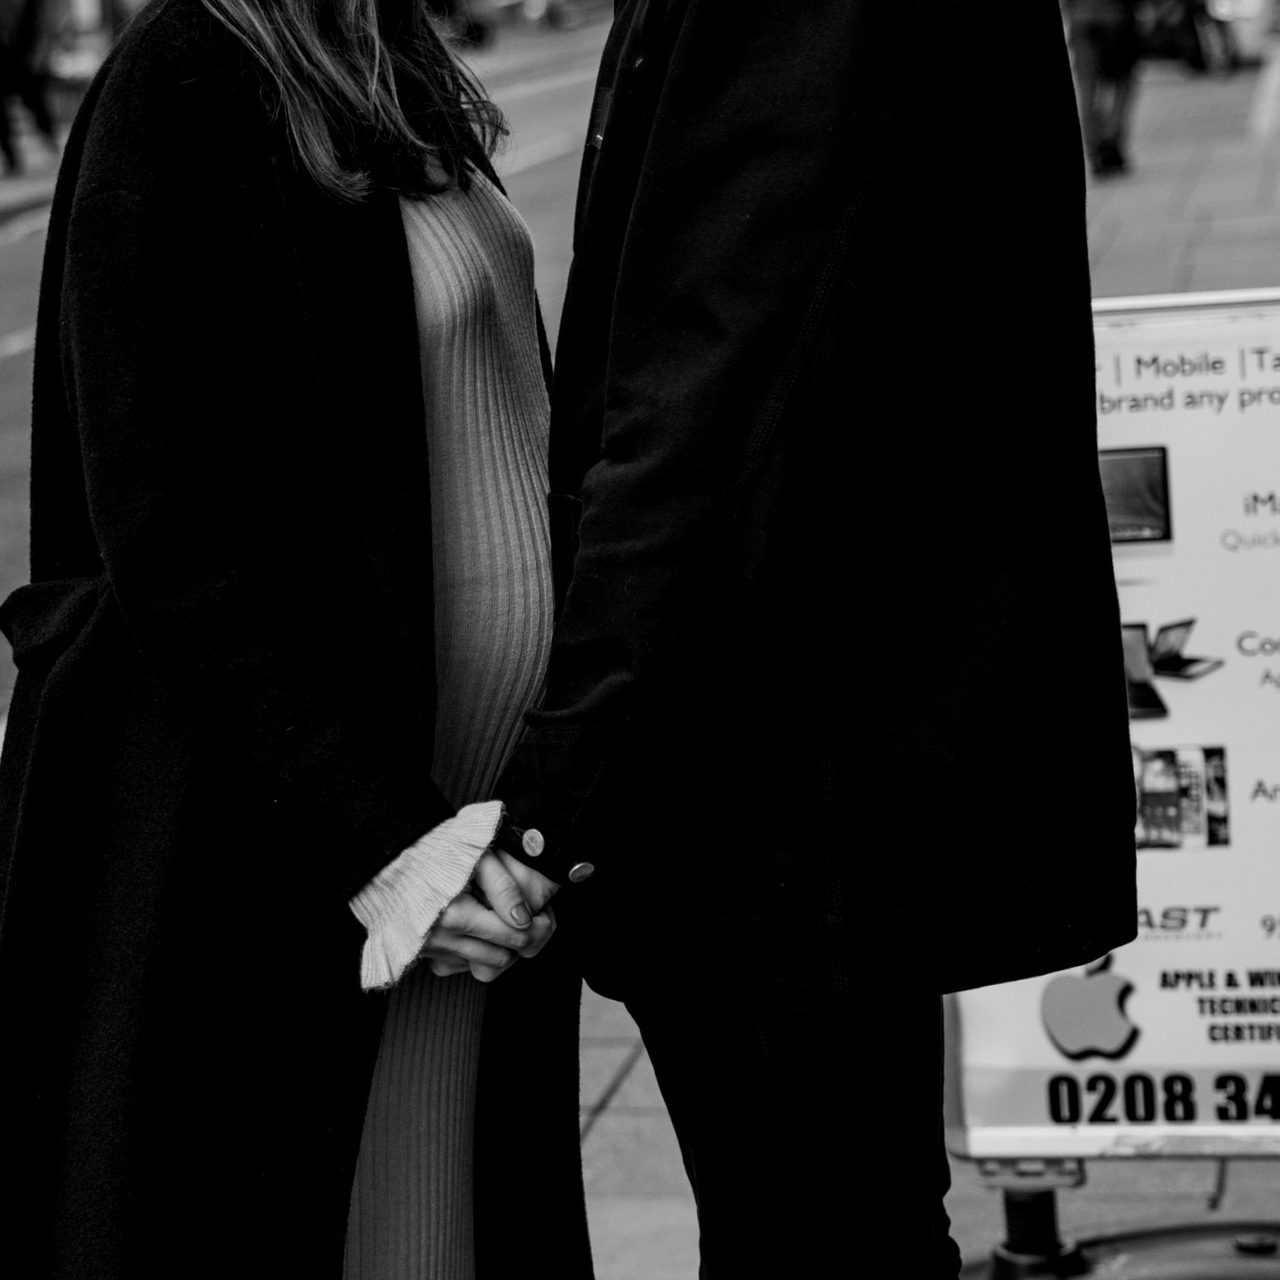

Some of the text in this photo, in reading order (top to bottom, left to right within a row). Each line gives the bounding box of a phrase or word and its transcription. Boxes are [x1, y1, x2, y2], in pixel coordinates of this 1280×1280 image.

[1135, 351, 1226, 378] Mobile
[1099, 386, 1174, 415] brand
[1183, 390, 1229, 416] any
[1243, 492, 1280, 517] iM
[1236, 629, 1280, 657] Co
[1160, 968, 1217, 990] APPLE
[1224, 969, 1240, 989] &
[1048, 1073, 1280, 1123] 0208 34
